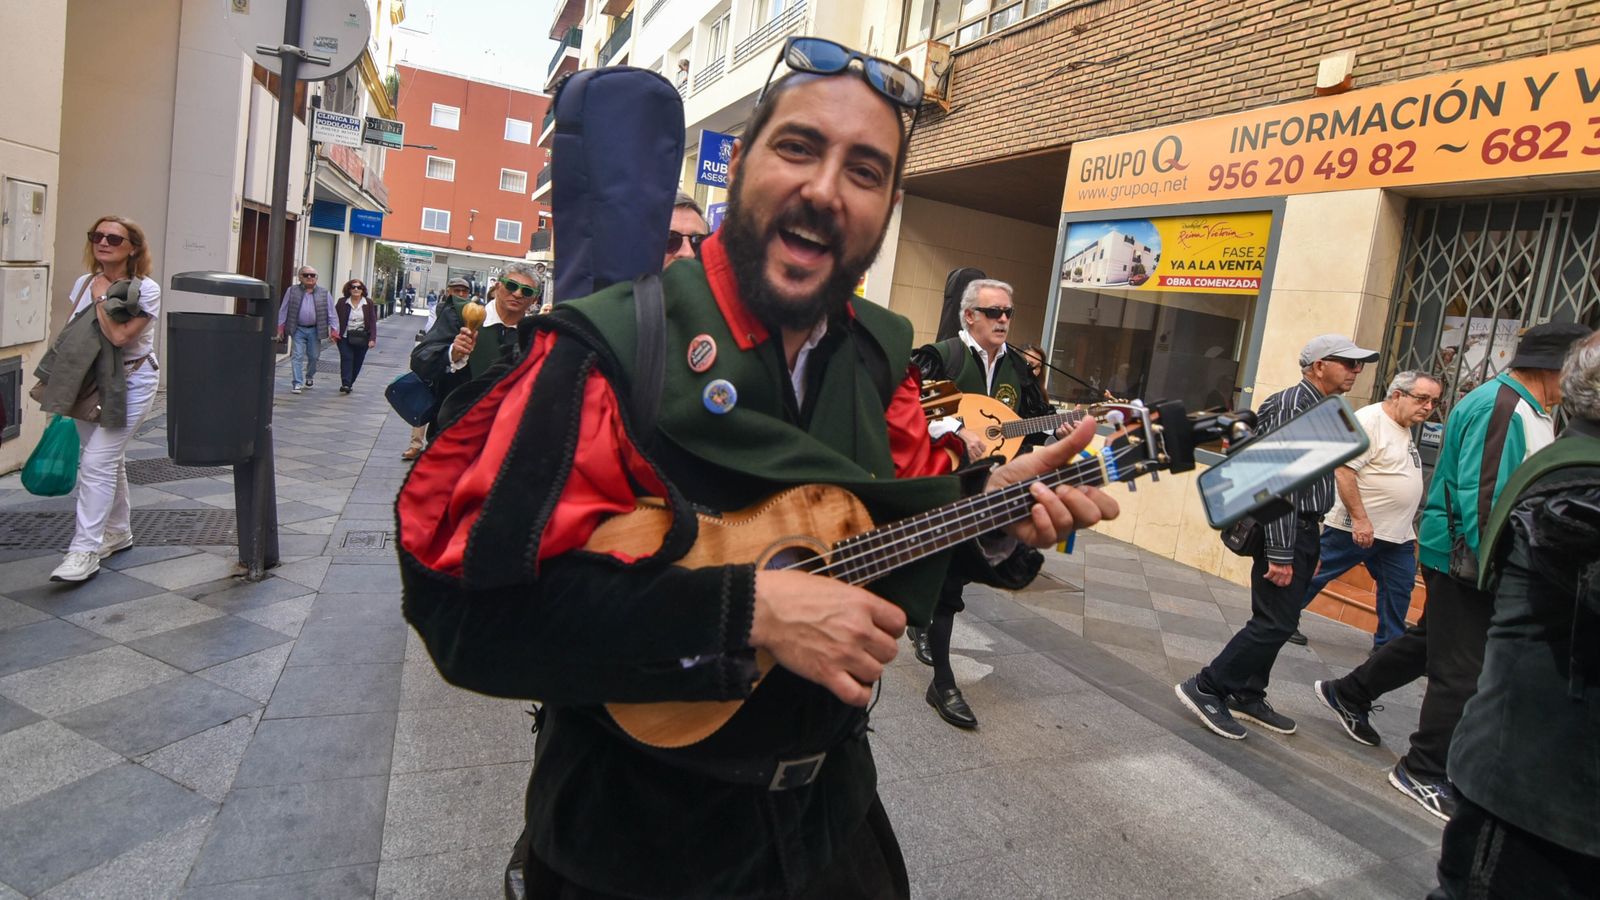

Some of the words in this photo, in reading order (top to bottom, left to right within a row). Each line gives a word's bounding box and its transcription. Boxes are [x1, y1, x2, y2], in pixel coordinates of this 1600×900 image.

[348, 117, 360, 125] DE
[1229, 79, 1506, 154] INFORMACIÓN
[1524, 71, 1560, 111] Y
[1080, 149, 1147, 183] GRUPO
[1151, 135, 1192, 173] Q
[1207, 159, 1259, 192] 956
[1265, 154, 1305, 186] 20
[1313, 147, 1358, 180] 49
[1368, 140, 1417, 176] 82
[1480, 120, 1572, 166] 682
[1078, 175, 1188, 201] www.grupoq.net
[1222, 247, 1255, 258] FASE
[1257, 246, 1266, 258] 2
[1170, 260, 1185, 270] YA
[1187, 260, 1197, 270] A
[1199, 260, 1215, 270] LA
[1218, 260, 1263, 271] VENTA
[1166, 277, 1192, 287] OBRA
[1193, 278, 1258, 289] COMENZADA
